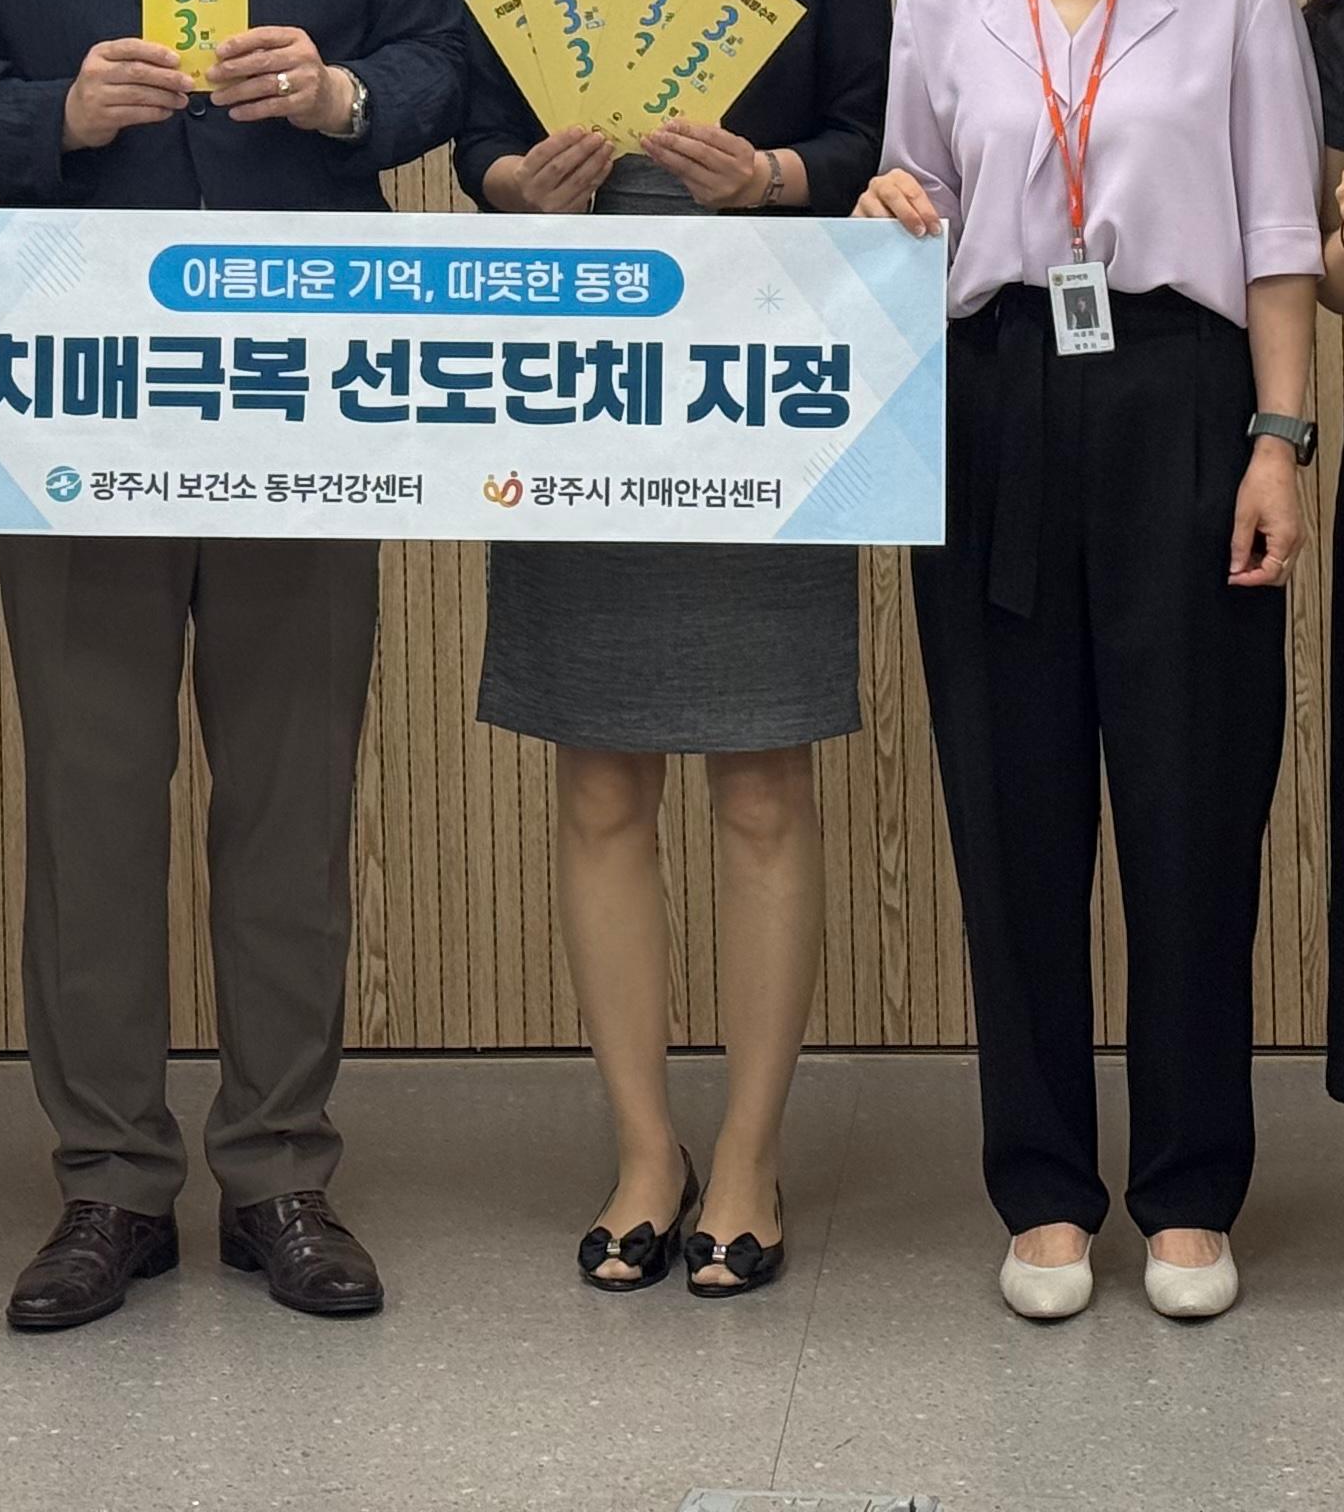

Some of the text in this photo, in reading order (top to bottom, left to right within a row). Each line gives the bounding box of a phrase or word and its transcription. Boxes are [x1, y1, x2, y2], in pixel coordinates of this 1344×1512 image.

[174, 8, 197, 51] 3
[702, 4, 739, 41] 3
[567, 38, 594, 78] 3
[673, 42, 710, 77] 3
[643, 78, 680, 114] 3
[182, 257, 651, 305] 아름다운 기억, 따뜻한 동행
[331, 338, 663, 427] 선도단체
[686, 342, 851, 430] 지정
[89, 470, 424, 506] 광주시 보건소 동부건강센터
[529, 475, 782, 510] 광주시 치매안심센터
